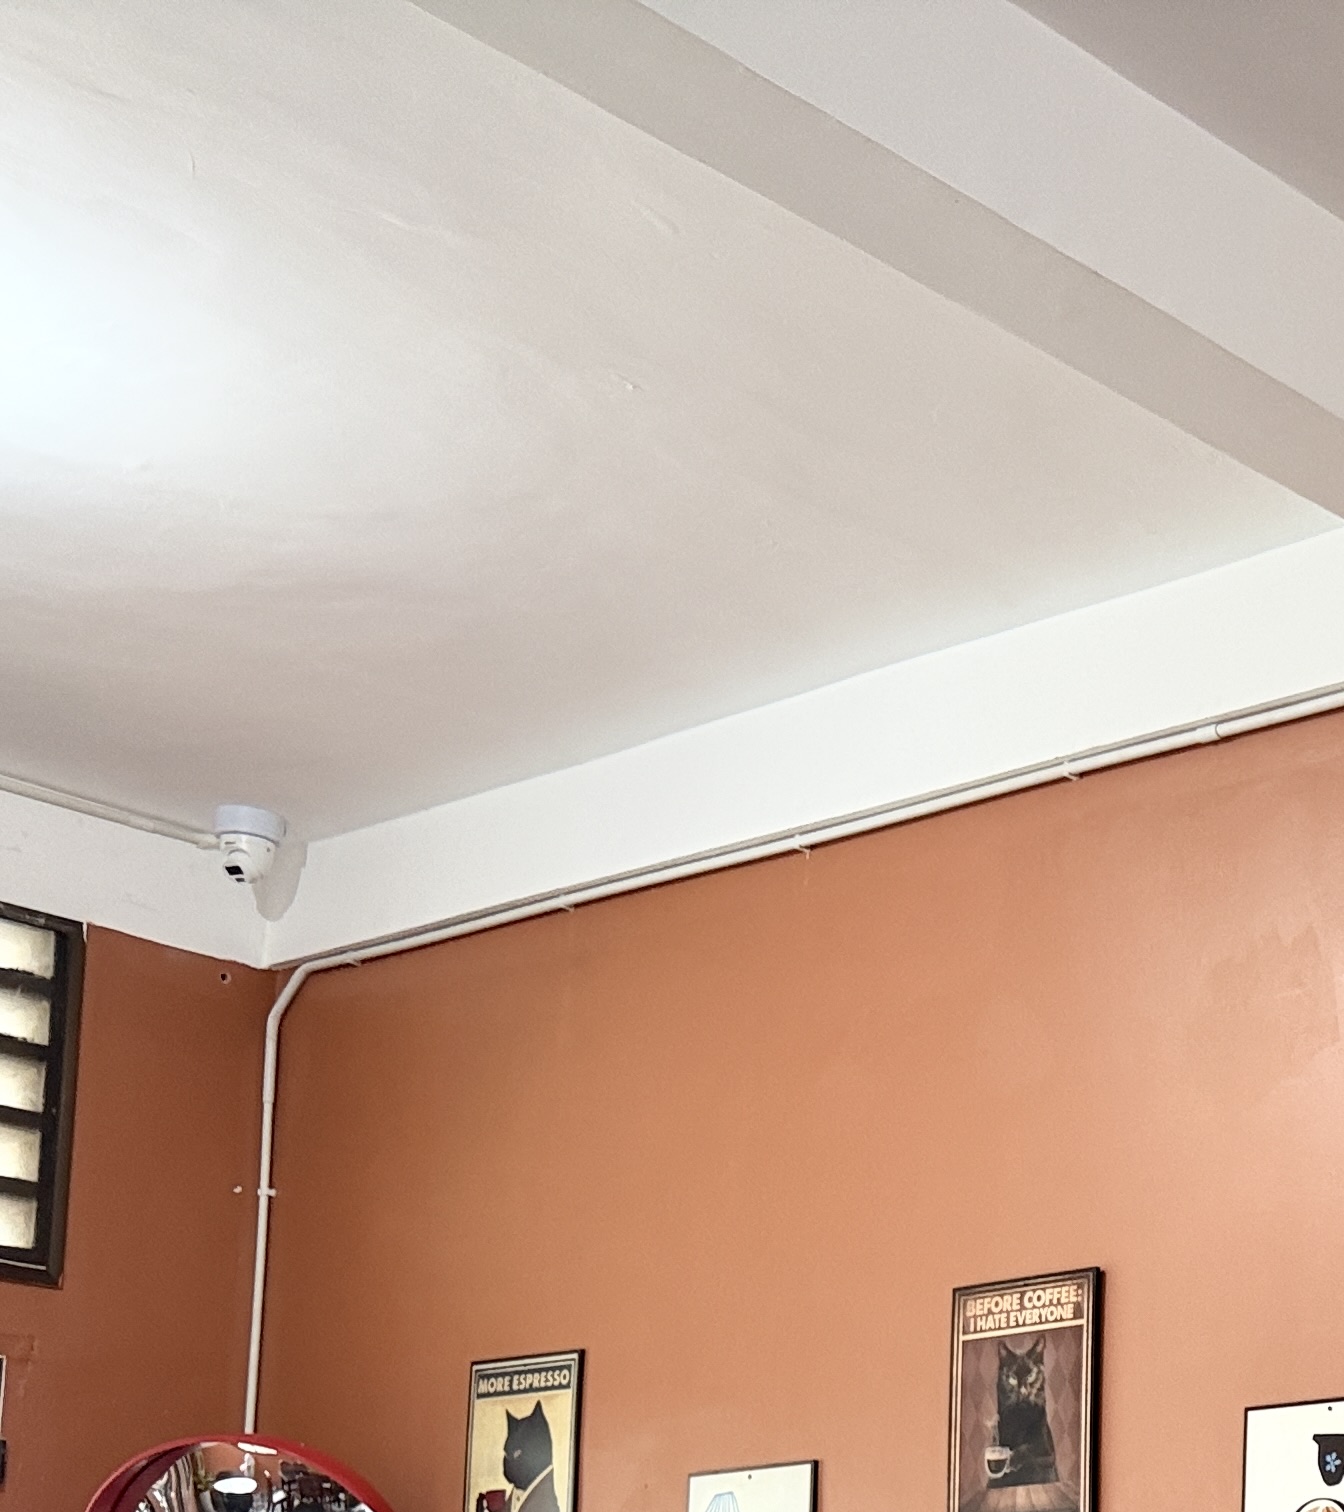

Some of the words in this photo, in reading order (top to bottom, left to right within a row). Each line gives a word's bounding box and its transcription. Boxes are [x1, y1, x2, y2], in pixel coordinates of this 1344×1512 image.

[966, 1293, 1021, 1317] BEFORE
[1024, 1285, 1083, 1309] COFFEE:
[969, 1318, 975, 1332] I
[976, 1312, 1008, 1331] HATE
[1009, 1304, 1074, 1327] EVERYONE
[478, 1376, 511, 1395] MORE
[512, 1369, 570, 1391] ESPRESSO
